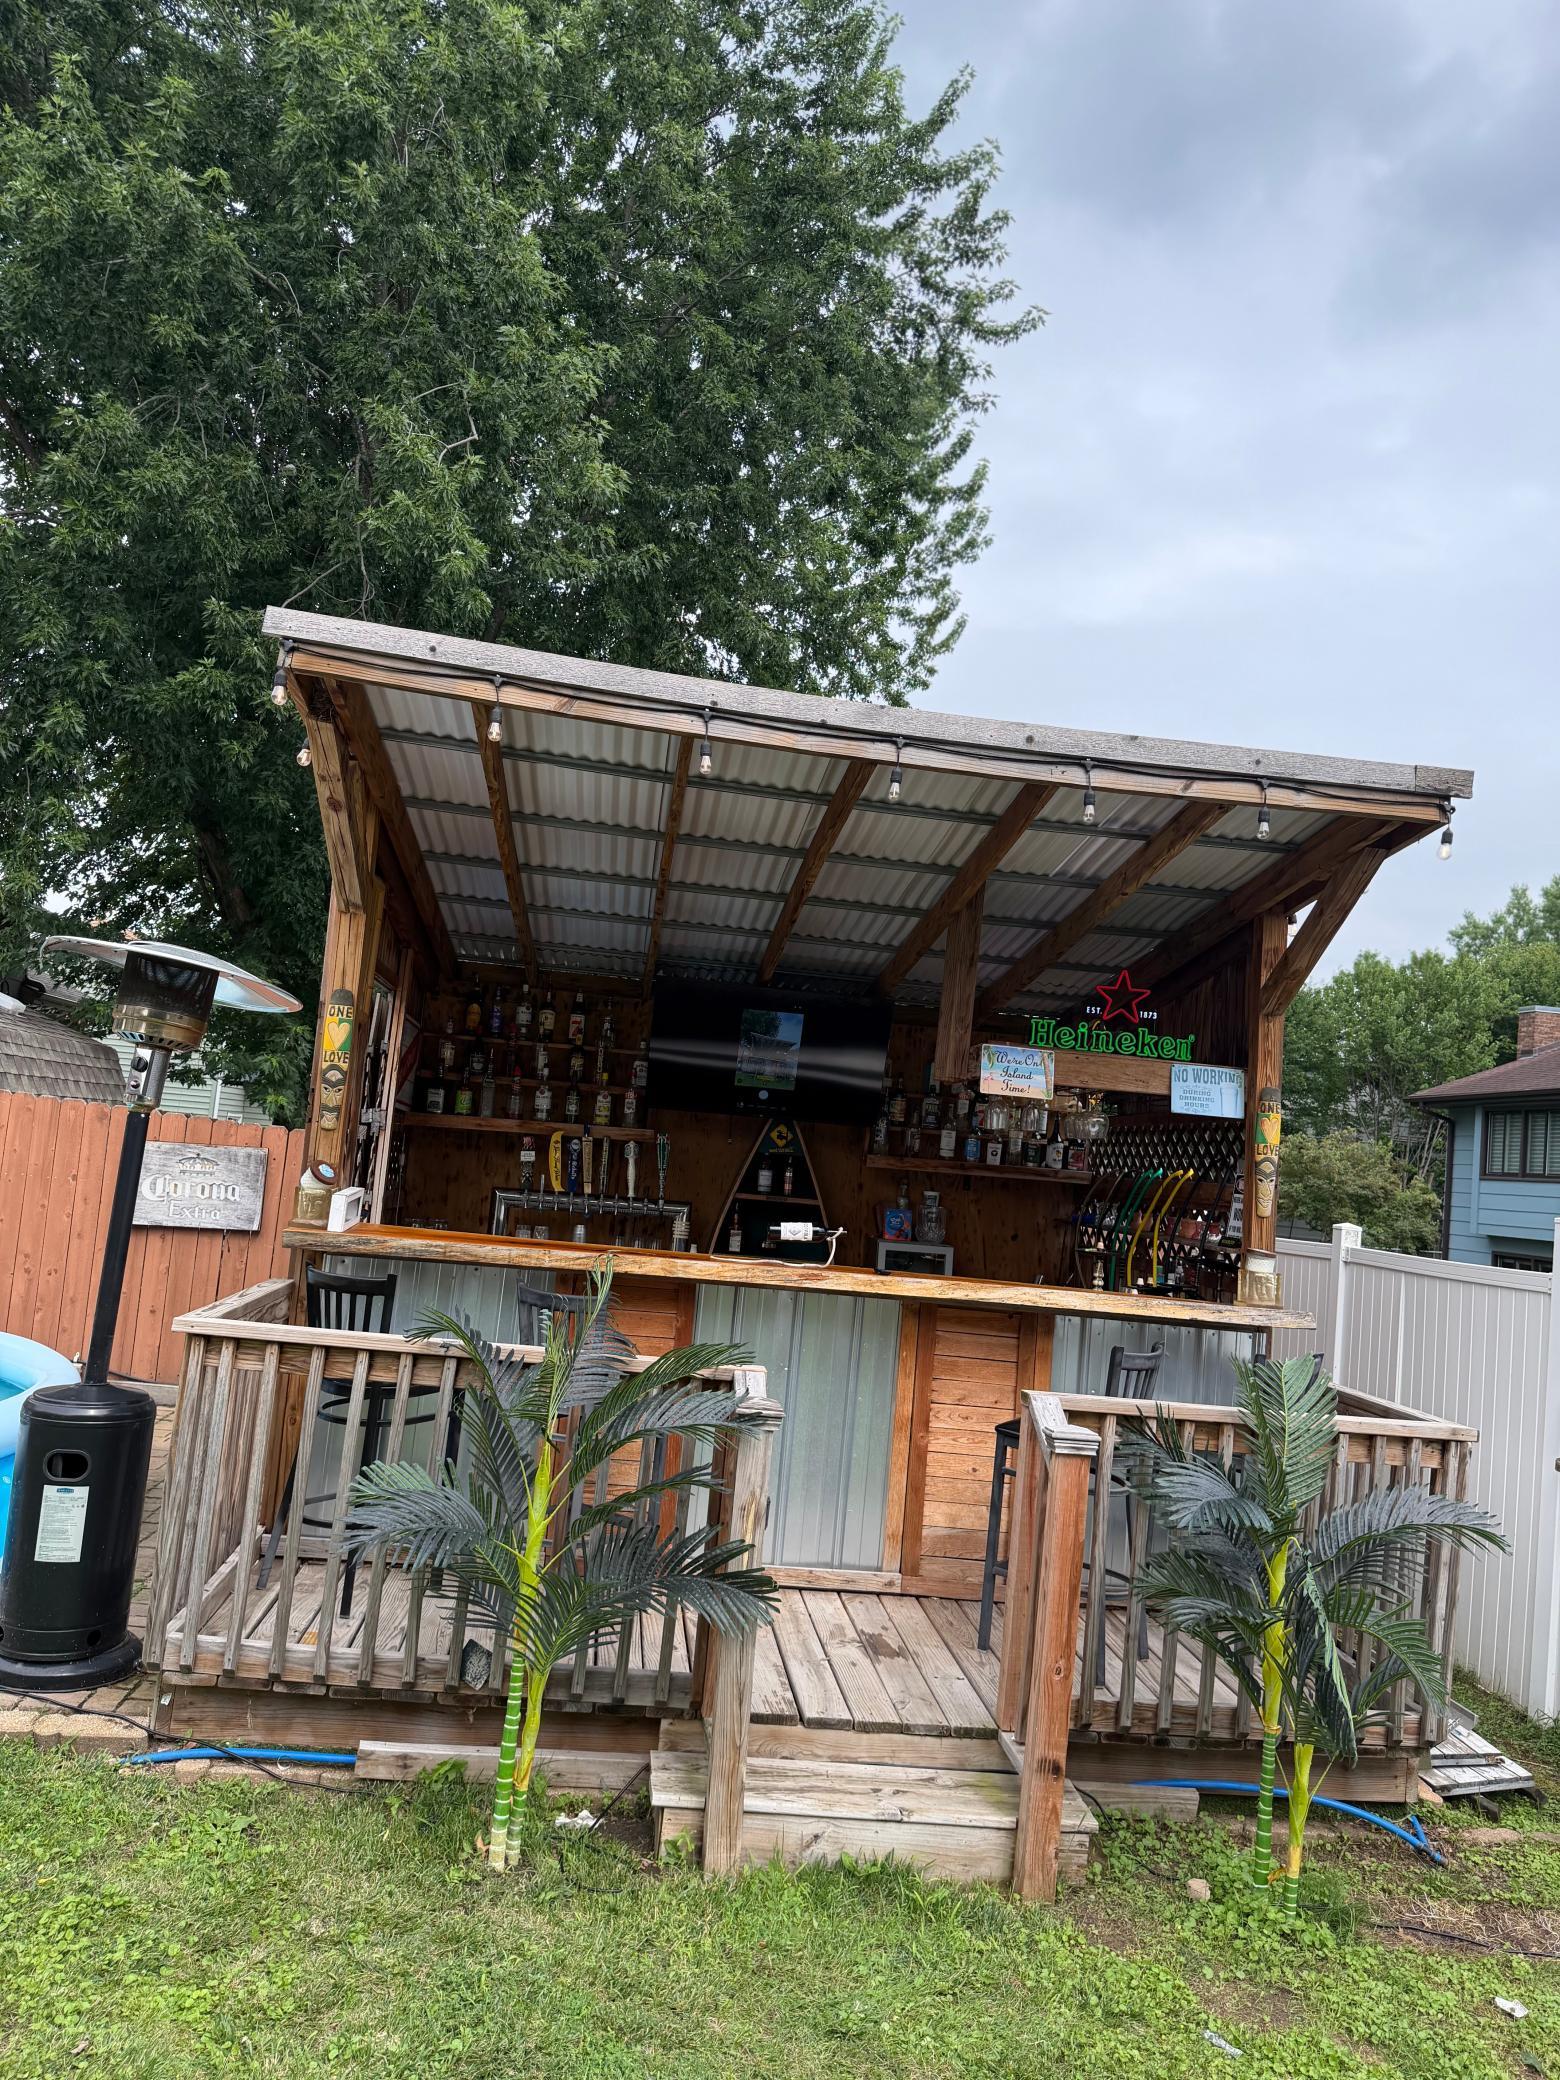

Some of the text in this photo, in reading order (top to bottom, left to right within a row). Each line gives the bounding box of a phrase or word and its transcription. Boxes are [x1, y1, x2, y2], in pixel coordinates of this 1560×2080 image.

[328, 1005, 354, 1018] ONE
[1086, 1006, 1158, 1019] EST. 1873
[323, 1050, 350, 1064] LOVE
[995, 1050, 1040, 1067] We're On
[1000, 1065, 1034, 1080] Island
[1174, 1067, 1243, 1089] NO WORKING
[1001, 1079, 1031, 1094] Time!
[1182, 1088, 1212, 1097] DURING
[1183, 1101, 1210, 1109] HOURS
[1260, 1102, 1281, 1114] ONE
[1256, 1143, 1280, 1156] LOVE
[141, 1173, 241, 1205] Corona
[169, 1199, 221, 1220] Extra
